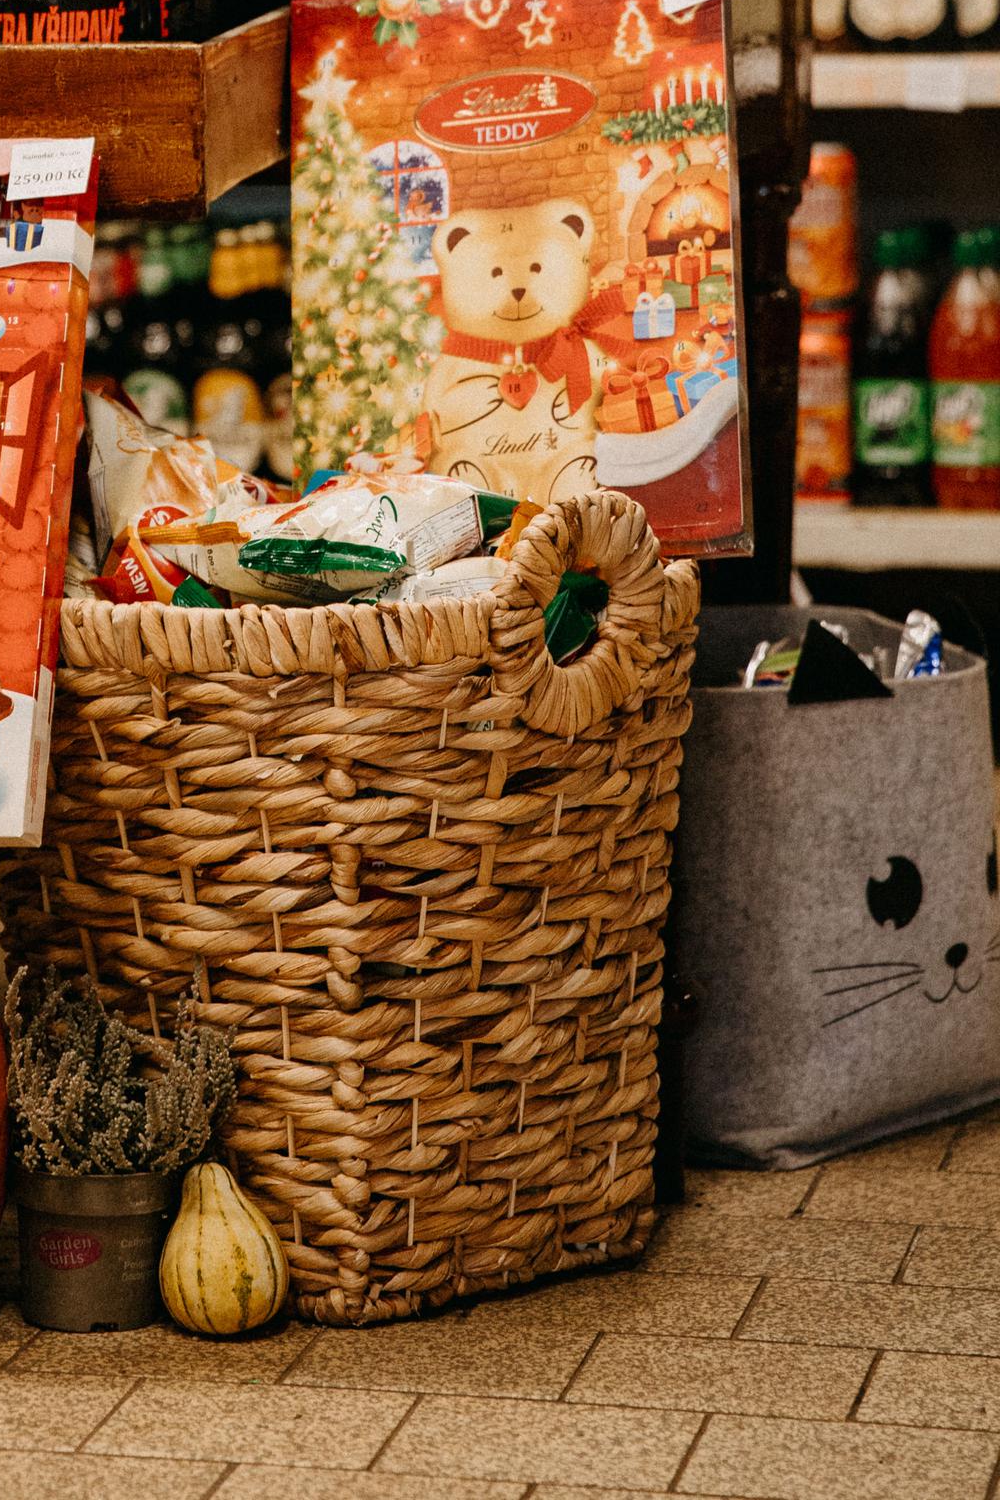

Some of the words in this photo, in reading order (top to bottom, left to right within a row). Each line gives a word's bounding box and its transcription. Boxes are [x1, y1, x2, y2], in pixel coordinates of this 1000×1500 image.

[474, 121, 540, 144] TEDDY
[13, 171, 63, 186] 259,00
[67, 168, 86, 179] Kč
[501, 223, 513, 233] 24
[7, 316, 19, 325] 13
[508, 383, 521, 393] 18
[481, 432, 542, 456] Lindt
[120, 556, 150, 594] NEW
[39, 1236, 91, 1251] Garden
[50, 1252, 84, 1267] Girls
